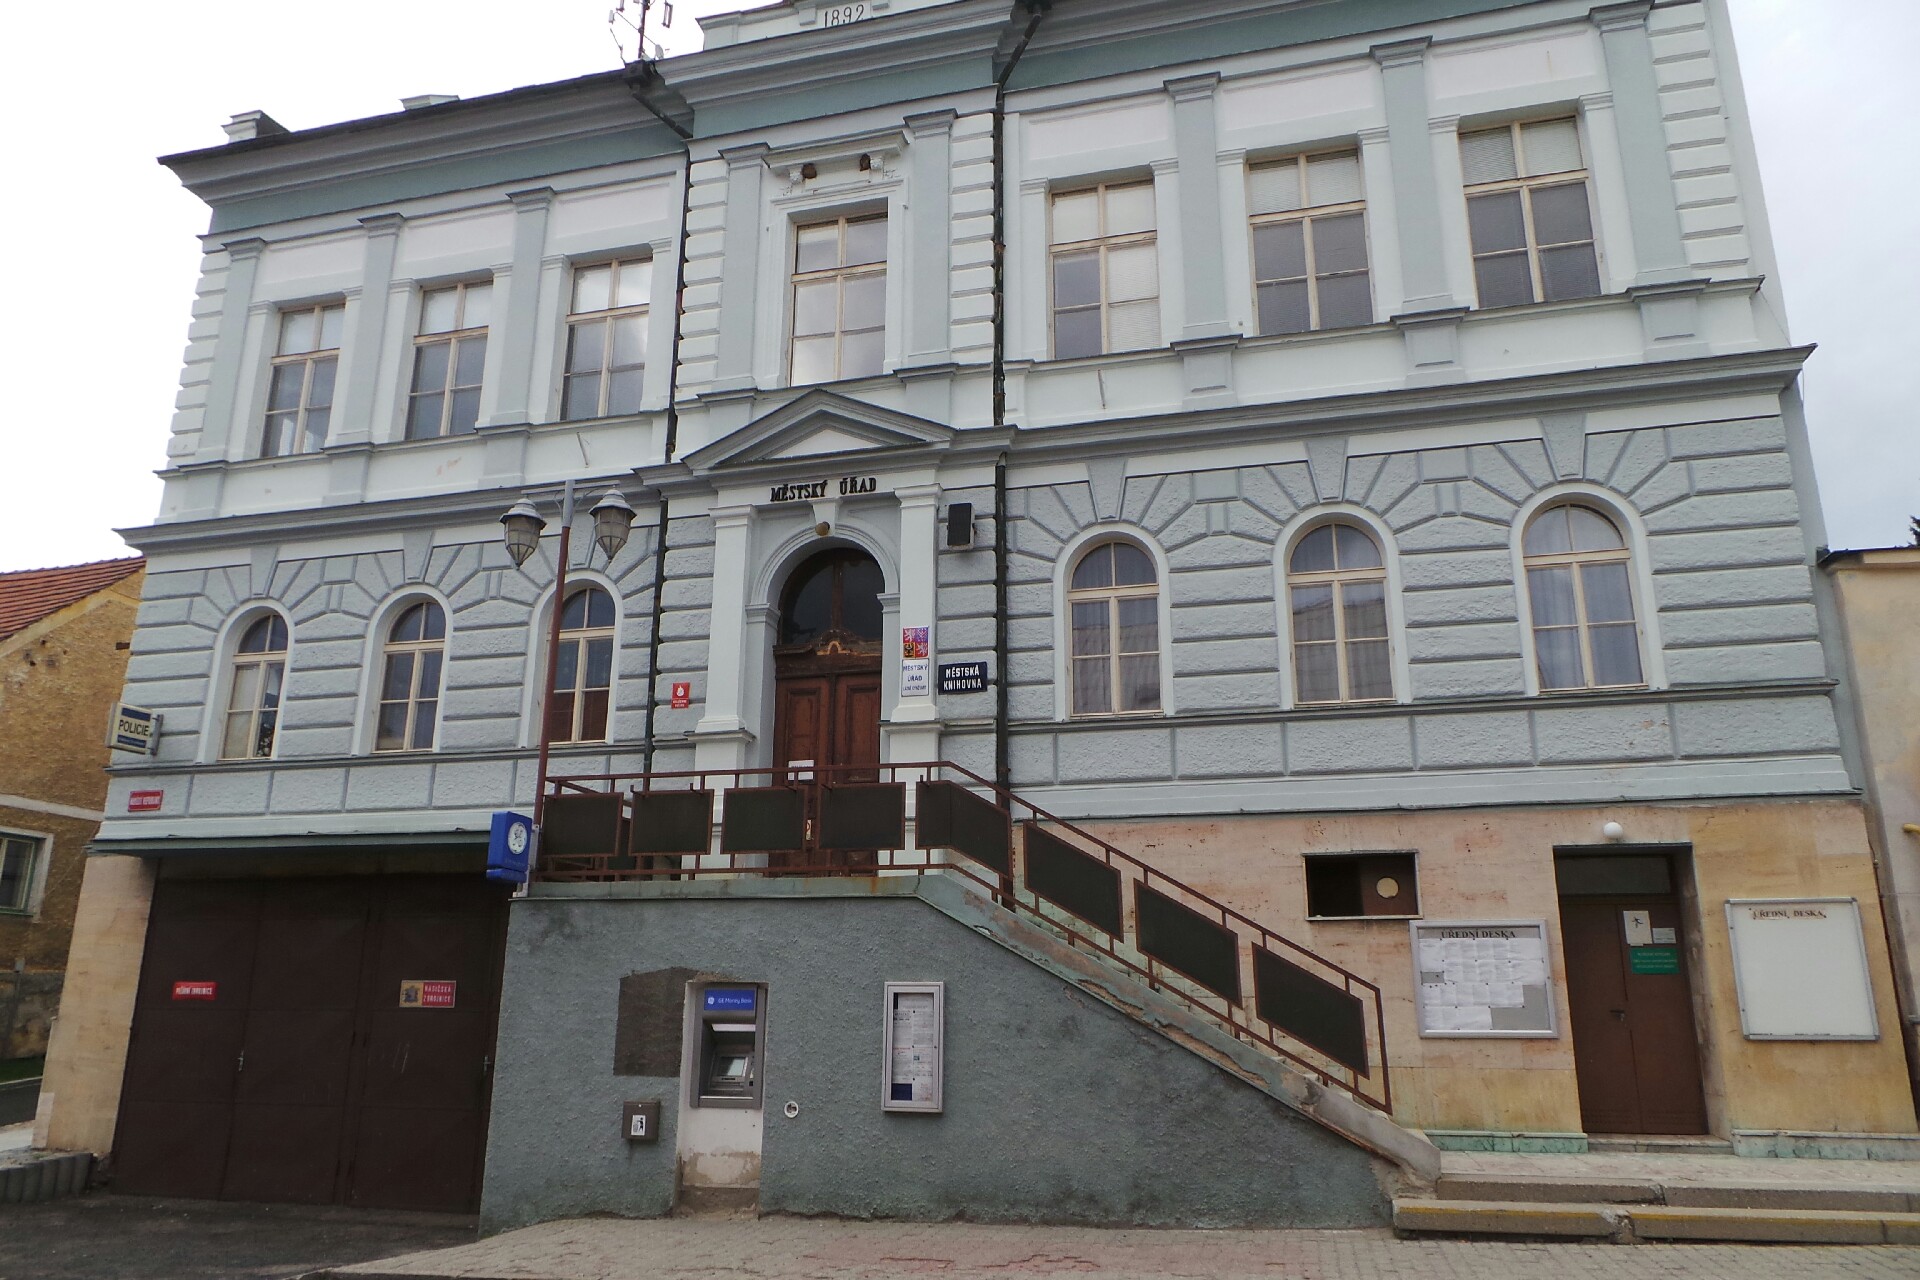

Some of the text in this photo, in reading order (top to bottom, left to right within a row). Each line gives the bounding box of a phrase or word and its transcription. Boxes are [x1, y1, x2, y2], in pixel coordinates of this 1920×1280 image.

[824, 4, 864, 28] 1892
[770, 476, 877, 502] MĚSTSKÝ ÚŘAD
[945, 664, 980, 679] MĚSTSKÁ
[943, 678, 982, 691] KNIHOVNA
[118, 719, 150, 737] POLICIE
[1793, 909, 1824, 917] DESKA
[1441, 928, 1516, 939] ÚŘEDNÍ DESKA
